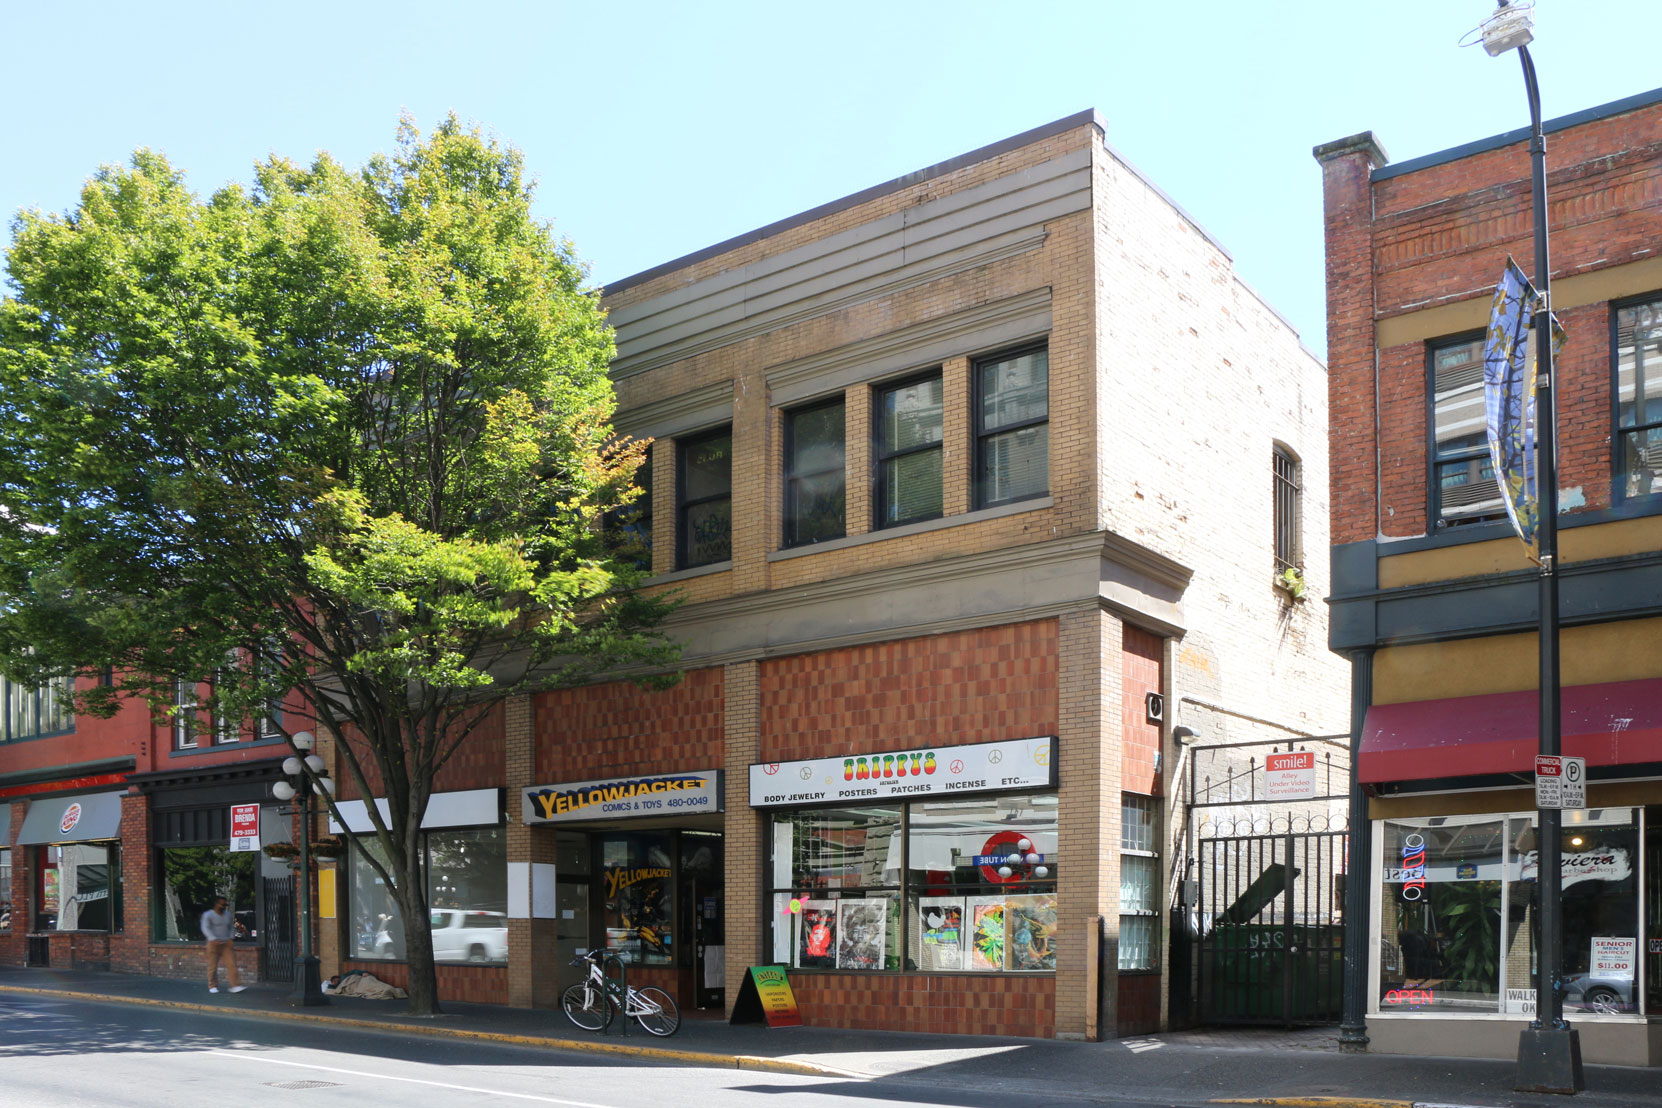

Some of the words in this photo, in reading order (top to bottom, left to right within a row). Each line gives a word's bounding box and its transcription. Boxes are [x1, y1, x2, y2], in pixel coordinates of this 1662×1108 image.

[843, 751, 937, 781] TRIPPYS
[1273, 755, 1307, 769] smile!
[1541, 766, 1556, 774] TRUCK
[1570, 765, 1577, 778] P
[764, 795, 786, 803] BODY
[788, 792, 826, 801] JEWELRY
[838, 788, 878, 797] POSTERS
[891, 784, 931, 793] PATCHES
[945, 779, 986, 790] INCENSE
[536, 778, 710, 819] YELLOWJACKET
[602, 802, 632, 813] COMICS
[634, 802, 639, 810] &
[642, 800, 662, 809] TOYS
[667, 796, 708, 807] 480-0049
[234, 813, 256, 823] BRENDA
[1386, 990, 1434, 1005] OPEN
[1508, 990, 1537, 1001] WALK
[1521, 1002, 1536, 1013] OK
